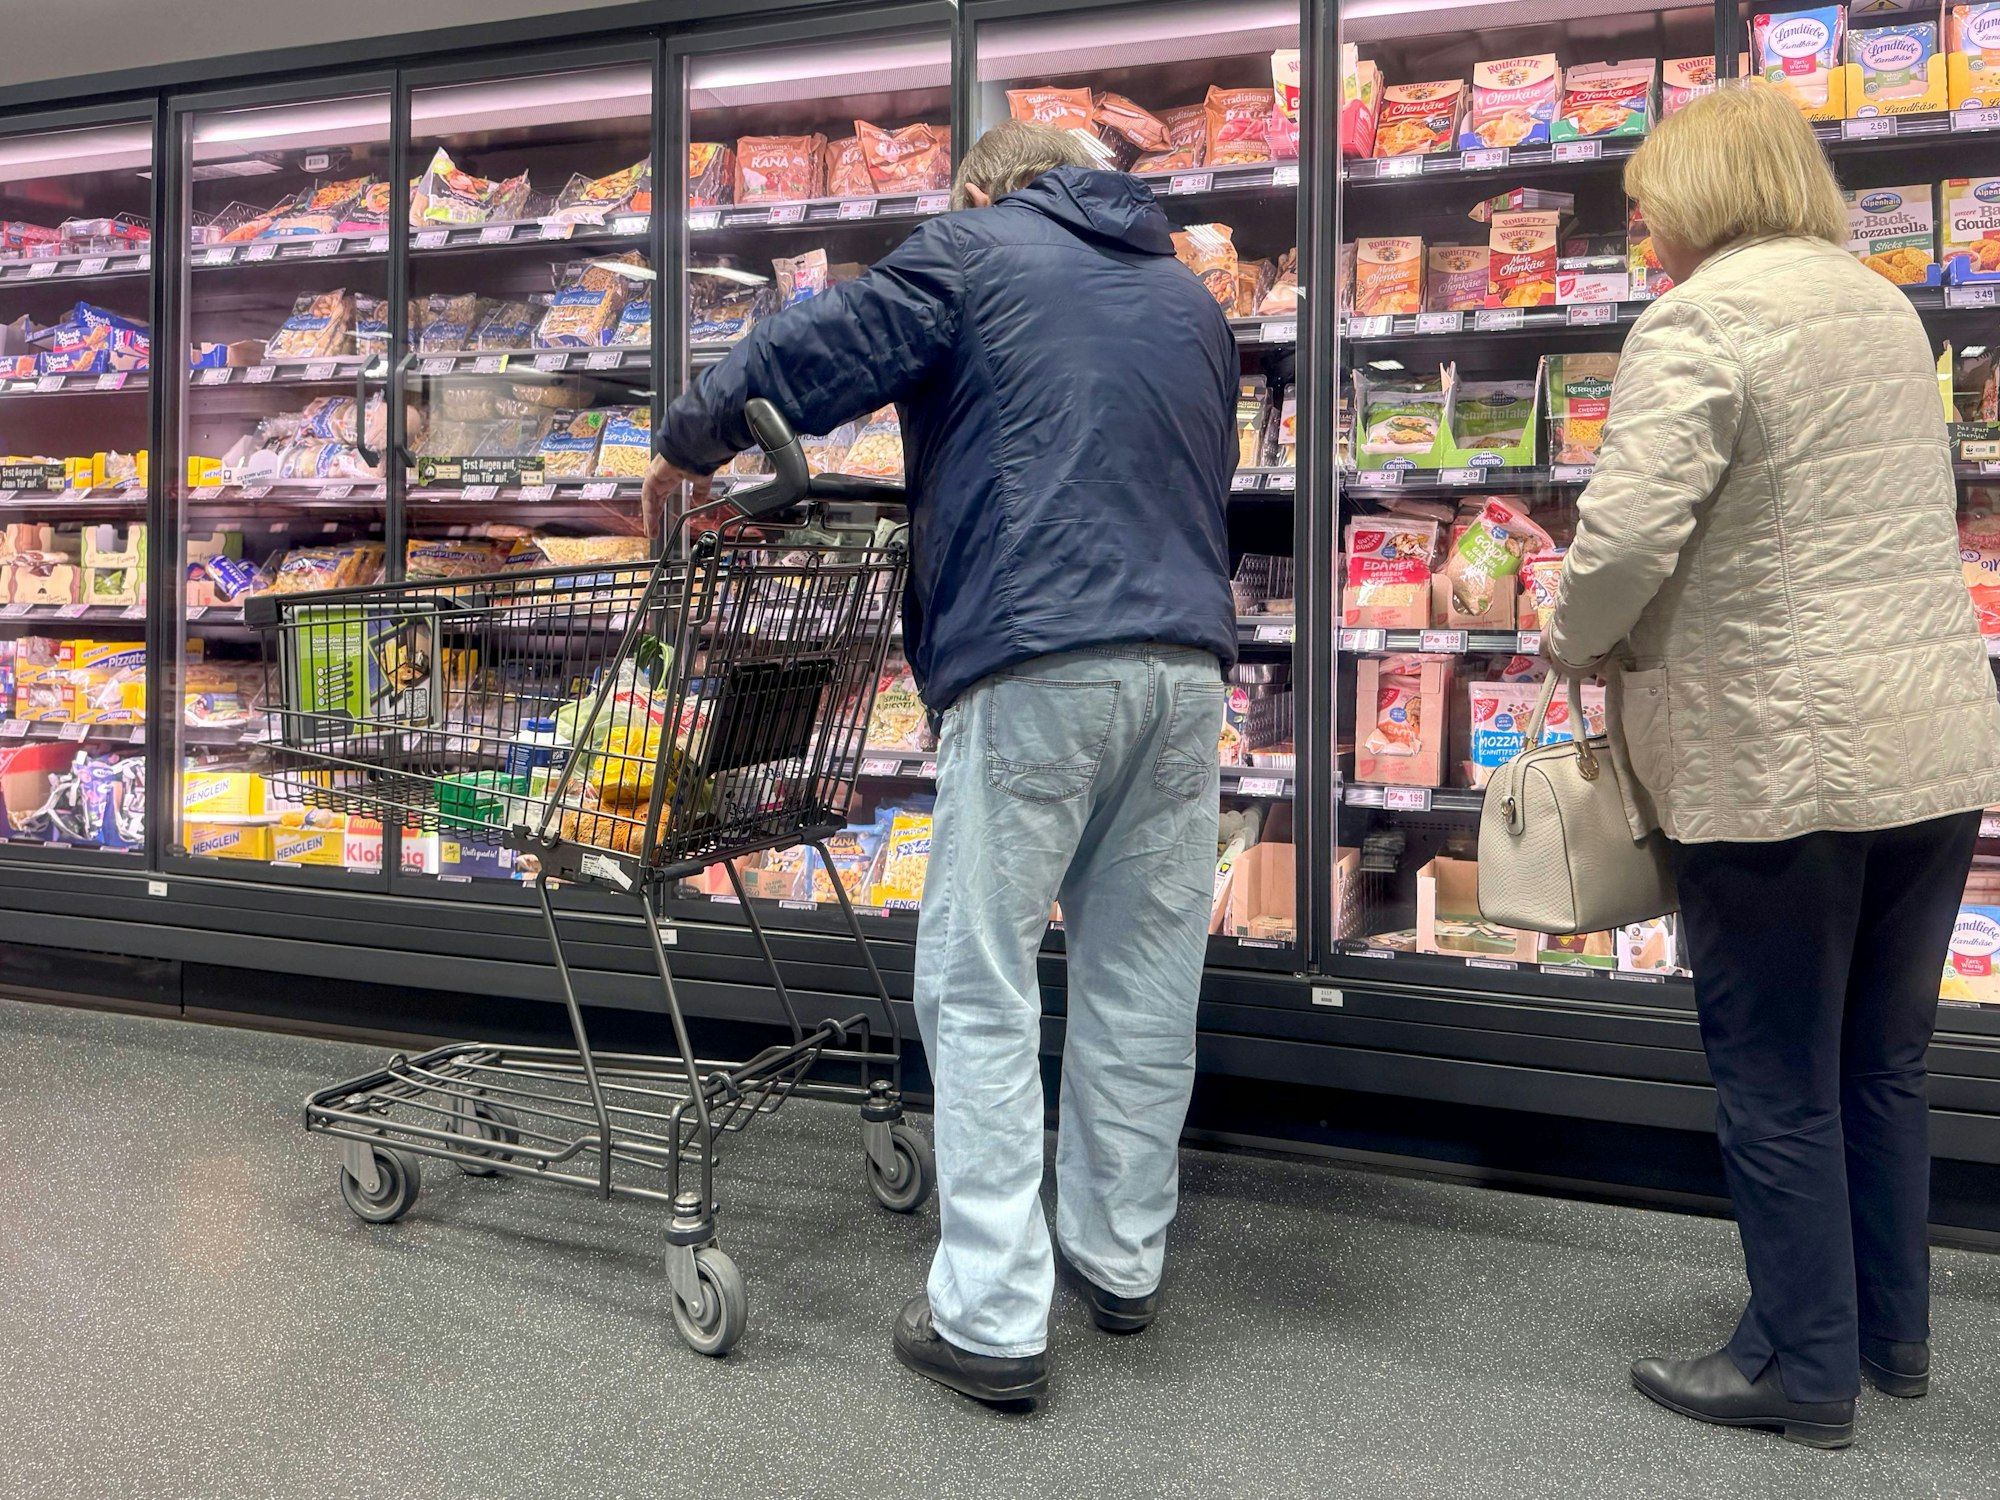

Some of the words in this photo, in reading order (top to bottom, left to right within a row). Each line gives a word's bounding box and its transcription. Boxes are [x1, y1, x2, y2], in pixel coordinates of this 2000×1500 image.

[1775, 23, 1824, 44] Landliebe
[1867, 40, 1918, 58] Landliebe
[1677, 57, 1714, 72] ROUGE
[1874, 55, 1912, 64] Landkäse
[1487, 59, 1542, 74] ROUGETTE
[1486, 88, 1540, 105] Ofenkäse
[1577, 89, 1633, 101] Ofenkäse
[1392, 101, 1446, 115] Ofenkäse
[1884, 102, 1937, 114] Landkäse
[751, 157, 789, 168] RANA
[1862, 198, 1901, 208] Alpenhain
[1954, 209, 1977, 217] unsere
[1979, 206, 2000, 218] Ba
[1502, 217, 1549, 226] ROUGETTE
[1850, 219, 1864, 227] ser
[1864, 212, 1916, 228] Back-
[1500, 230, 1547, 240] ROUGETTE
[1368, 240, 1412, 250] ROUGETTE
[1875, 241, 1903, 252] Sticks
[1438, 249, 1482, 259] ROUGETTE
[1509, 254, 1531, 265] Mein
[1376, 265, 1397, 274] Mein
[1500, 260, 1546, 276] Ofenkäse
[1367, 271, 1409, 285] Ofenkäse
[1448, 274, 1467, 283] Mein
[1438, 279, 1480, 293] Ofenkäse
[1974, 290, 1993, 299] 3.49
[1440, 317, 1455, 325] 3.49
[462, 459, 478, 470] Erst
[479, 459, 500, 472] Augen
[501, 459, 517, 471] auf,
[1472, 457, 1500, 466] GOLDSTEIG
[2, 467, 15, 477] Erst
[15, 467, 32, 479] Augen
[462, 473, 480, 483] dann
[481, 472, 495, 483] Tür
[495, 472, 509, 483] auf.
[2, 480, 16, 488] dann
[17, 479, 26, 488] Tür
[1363, 561, 1414, 571] EDAMER
[108, 653, 146, 668] Pizzate
[185, 780, 230, 805] HENGLEIN
[192, 831, 240, 855] HENGLEIN
[830, 836, 855, 846] RANA
[277, 836, 323, 861] HENGLEIN
[1954, 920, 1999, 940] andliebe
